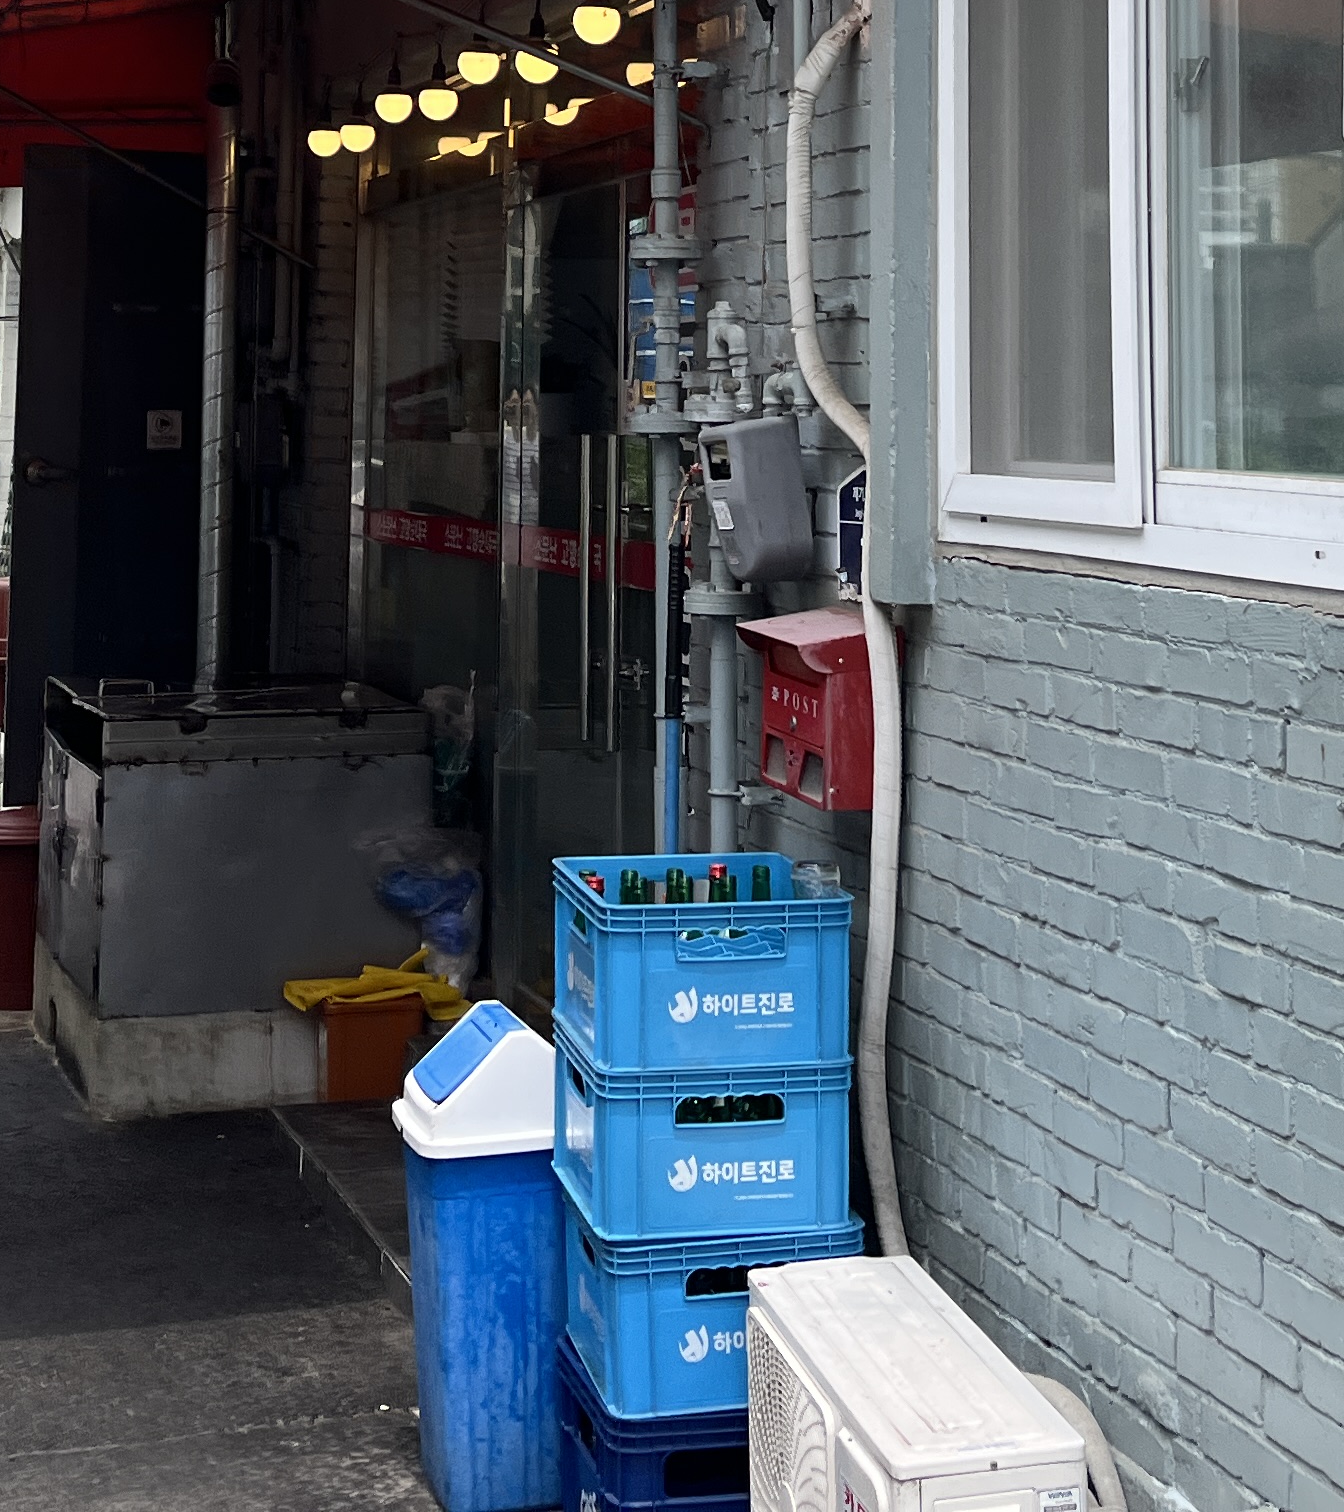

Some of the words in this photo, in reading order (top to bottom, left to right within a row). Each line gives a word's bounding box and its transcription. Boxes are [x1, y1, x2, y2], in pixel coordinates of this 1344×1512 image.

[783, 688, 818, 719] POST
[702, 992, 795, 1017] 하이트진로
[701, 1159, 796, 1185] 하이트진로
